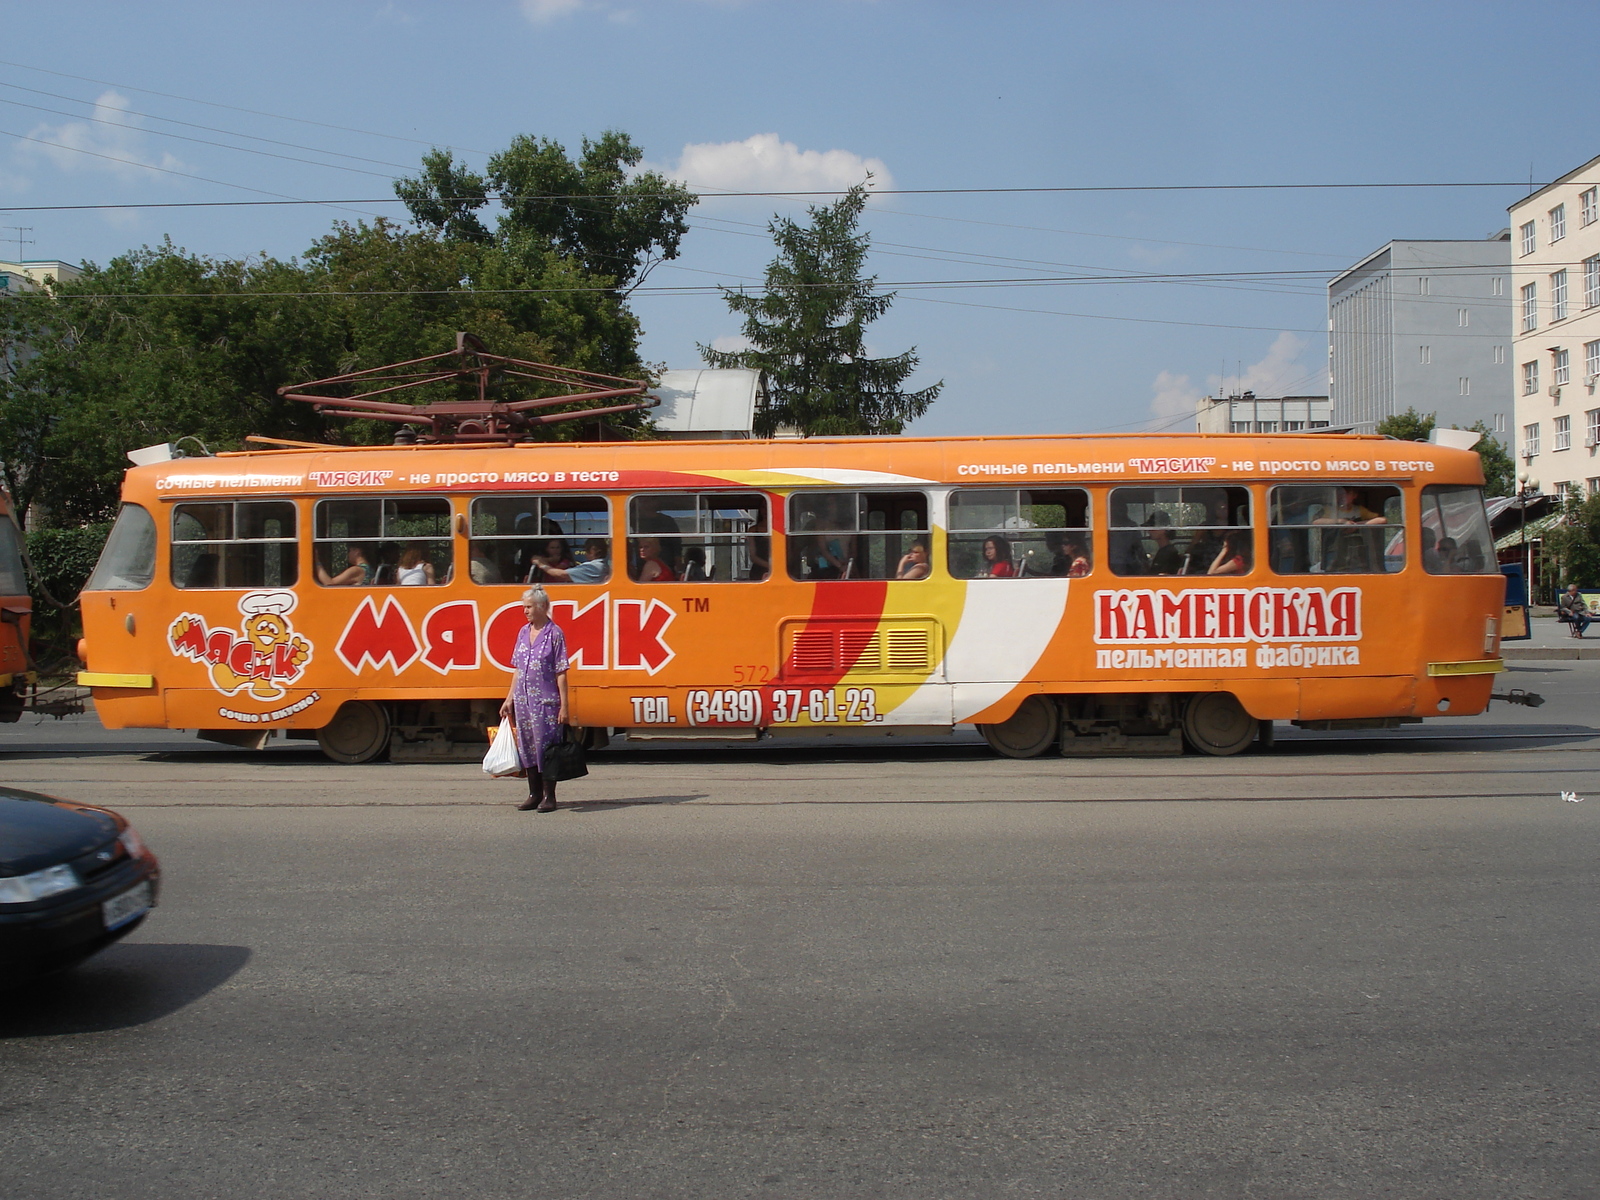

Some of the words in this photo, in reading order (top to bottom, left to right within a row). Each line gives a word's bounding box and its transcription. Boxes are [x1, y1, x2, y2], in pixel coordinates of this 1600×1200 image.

[957, 464, 1028, 476] сочные
[1032, 462, 1125, 475] пельмени
[1232, 460, 1255, 472] не
[1259, 460, 1322, 475] просто
[1326, 460, 1371, 471] мясо
[1374, 460, 1387, 471] в
[1389, 459, 1435, 472] тесте
[156, 477, 216, 490] сочные
[220, 475, 302, 489] пельмени
[409, 473, 431, 484] не
[435, 471, 499, 487] просто
[503, 471, 550, 483] мясо
[554, 471, 566, 482] в
[569, 470, 620, 482] тесте
[1096, 590, 1360, 642] КАМЕНСКАЯ
[1096, 648, 1248, 669] пельменная
[1255, 644, 1360, 669] фабрика
[733, 665, 770, 683] 572
[631, 697, 677, 723] тел.
[686, 690, 763, 726] (3439)
[772, 688, 884, 722] 37-61-23.
